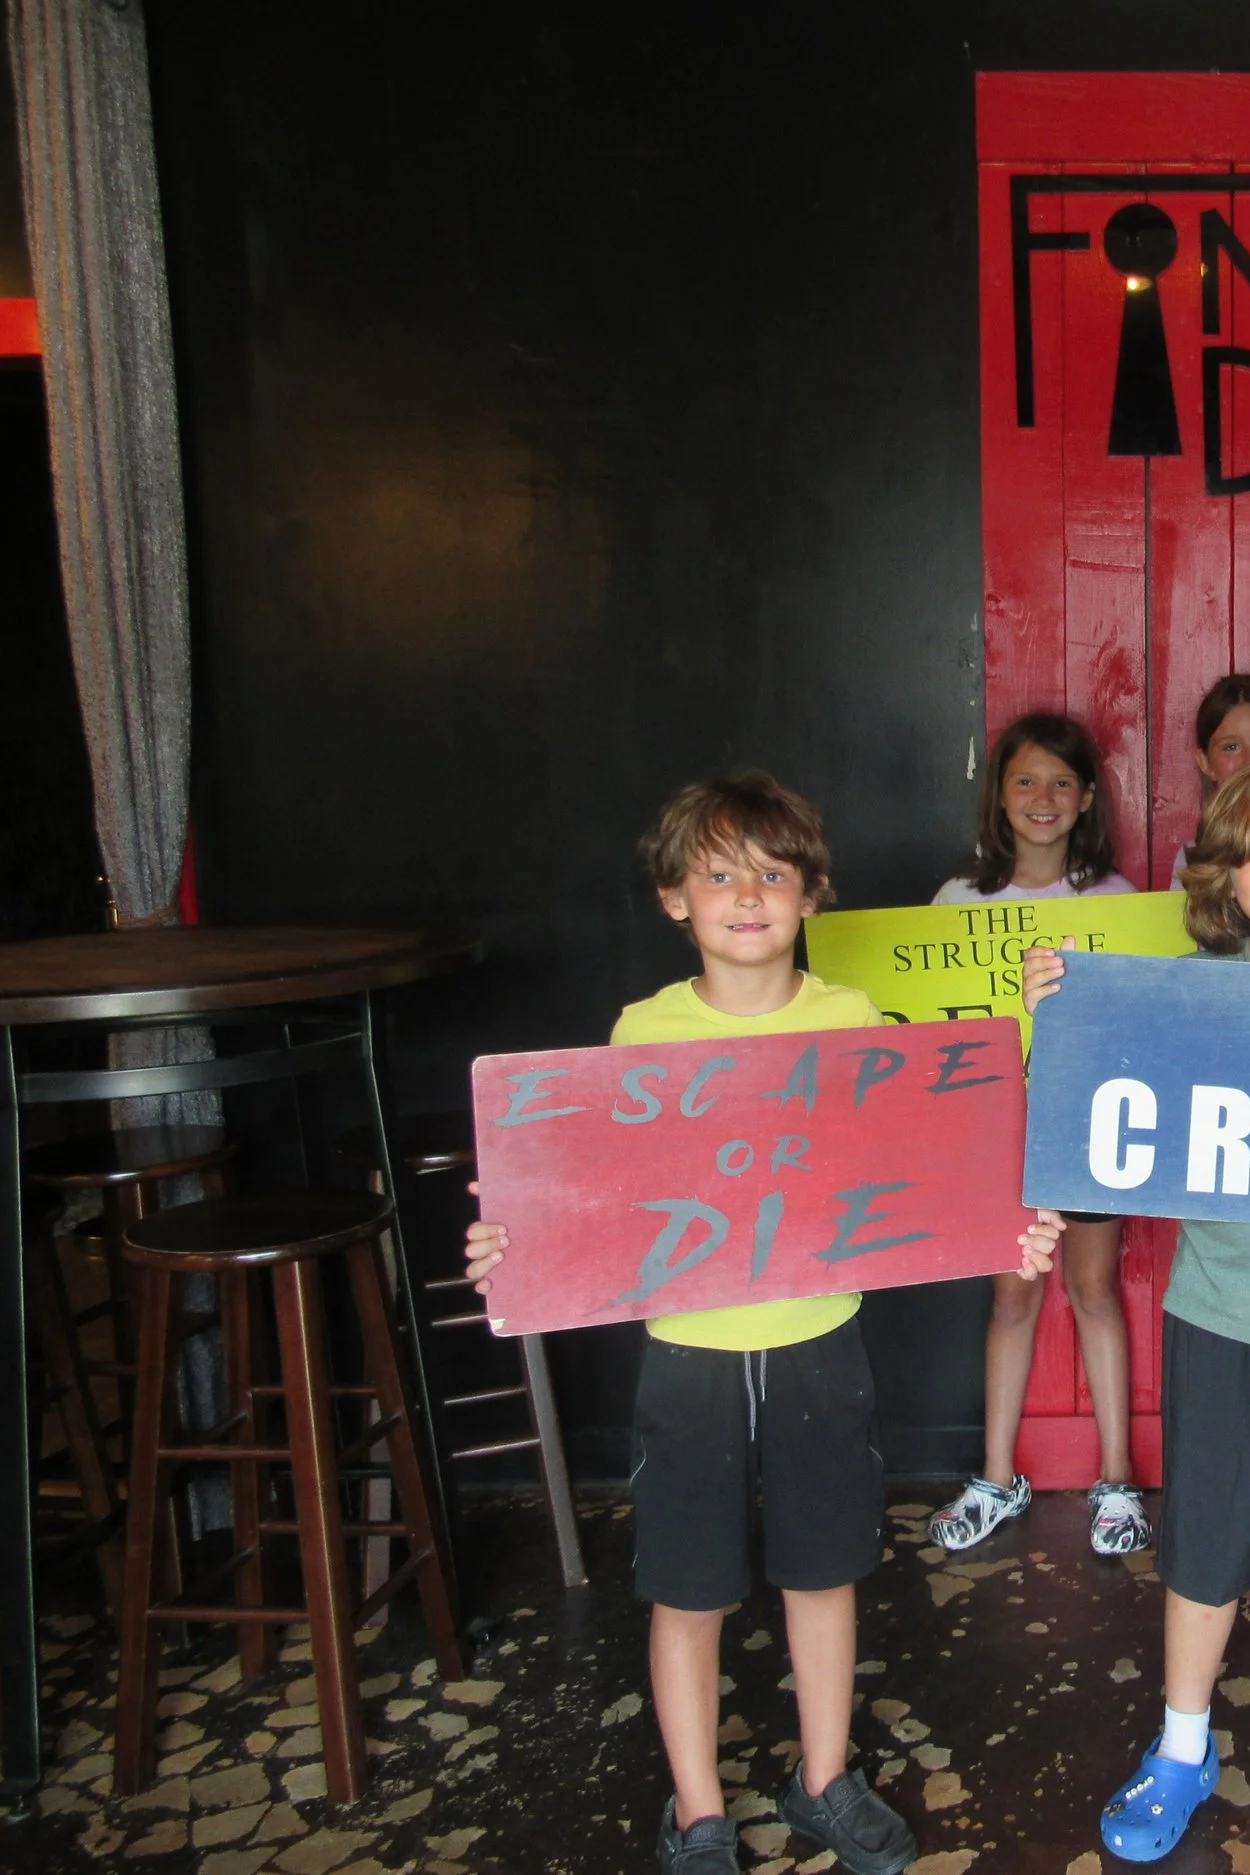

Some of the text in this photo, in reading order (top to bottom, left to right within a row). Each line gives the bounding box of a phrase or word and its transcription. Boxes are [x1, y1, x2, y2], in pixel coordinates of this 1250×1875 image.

[959, 905, 1038, 936] THE
[893, 933, 1105, 973] STRUGE
[989, 969, 1021, 997] IS
[493, 1042, 1012, 1127] ESCAPE
[716, 1135, 814, 1176] OR
[586, 1181, 942, 1315] DIE
